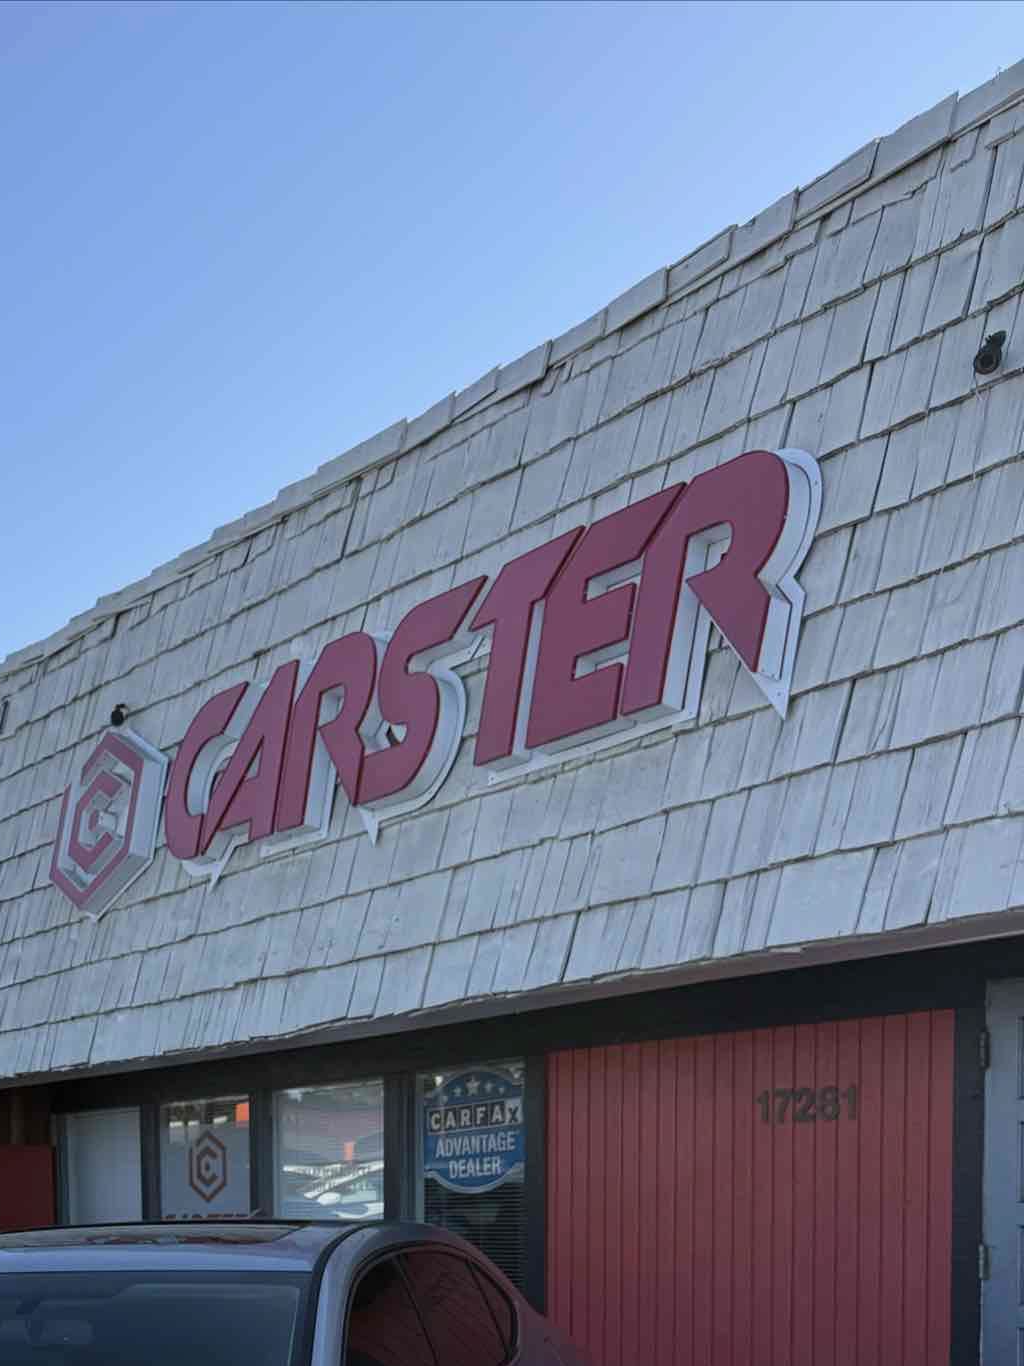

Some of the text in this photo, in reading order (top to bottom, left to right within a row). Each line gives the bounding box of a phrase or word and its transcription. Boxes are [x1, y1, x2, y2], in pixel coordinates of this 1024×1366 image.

[164, 448, 816, 875] CARSTER
[756, 1083, 858, 1124] 17281
[430, 1104, 520, 1131] CARFAX
[435, 1131, 516, 1158] ADVANTAGE
[448, 1157, 502, 1179] DEALER
